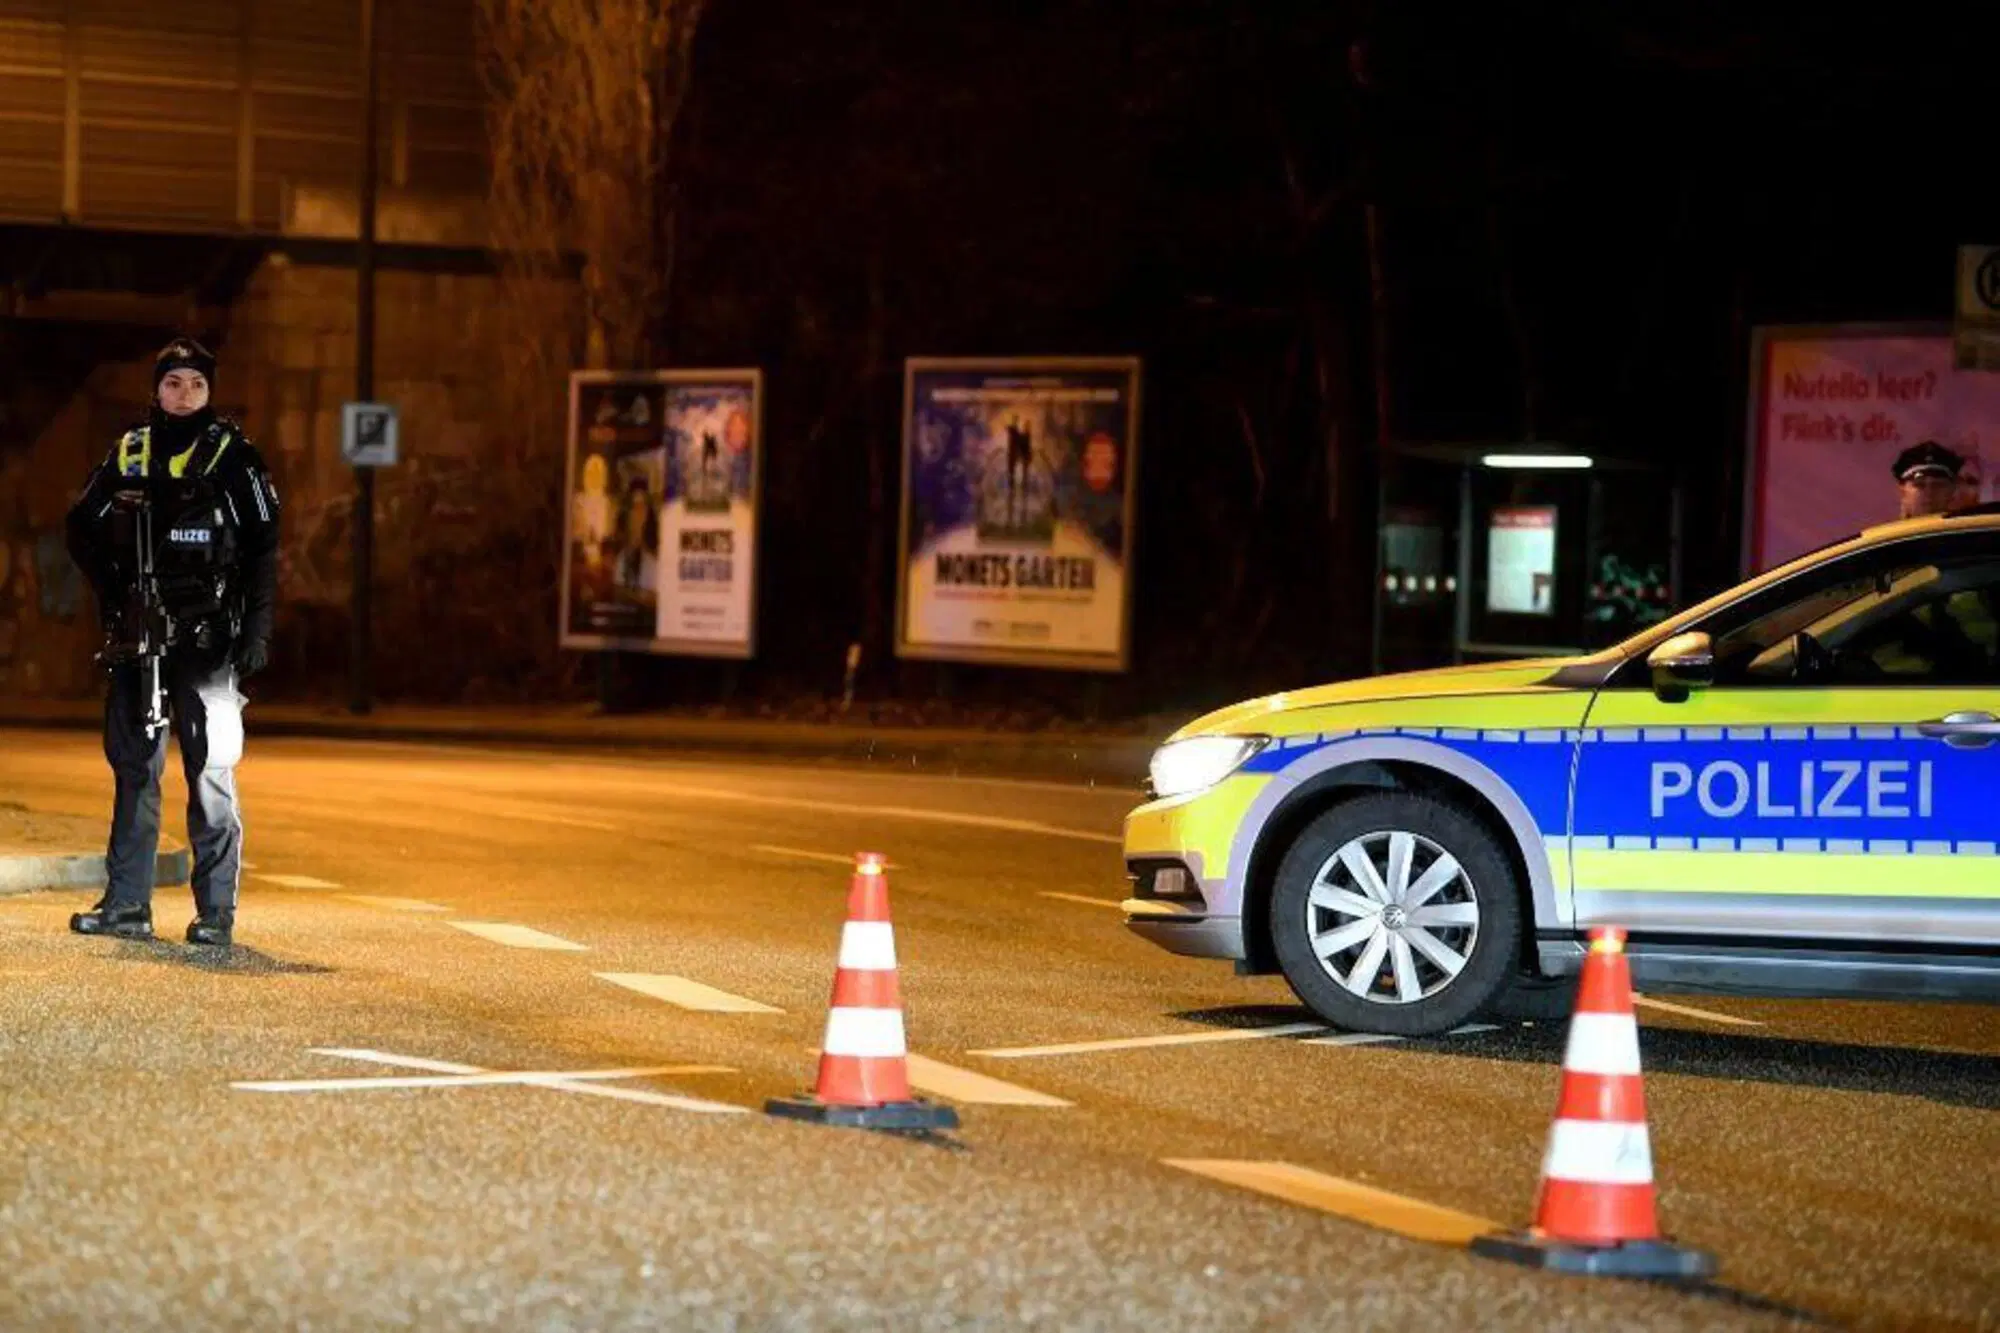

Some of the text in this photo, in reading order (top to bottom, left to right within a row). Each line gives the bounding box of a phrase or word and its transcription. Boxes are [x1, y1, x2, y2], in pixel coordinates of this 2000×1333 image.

[1784, 370, 1935, 401] Nutella leer?
[169, 528, 210, 543] OLIZEI
[937, 552, 1095, 589] MONETS GARTEN
[1650, 760, 1933, 818] POLIZEI
